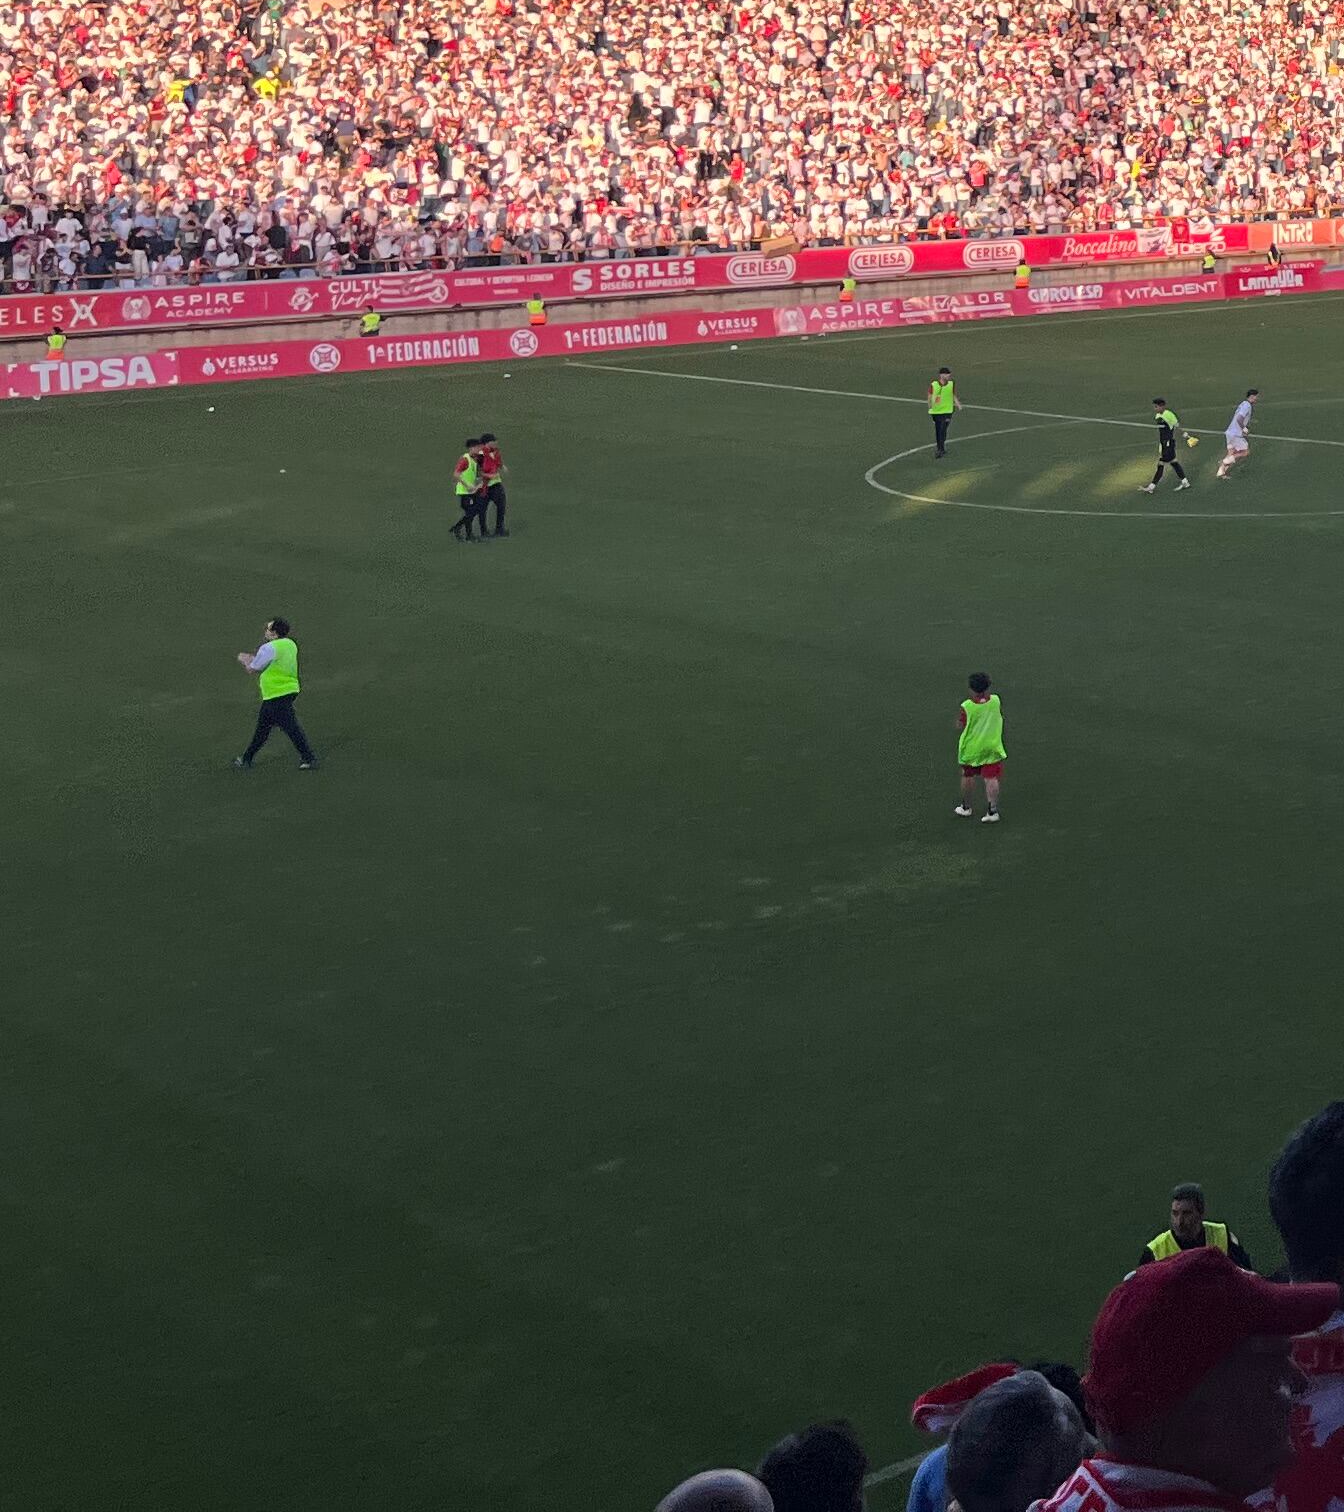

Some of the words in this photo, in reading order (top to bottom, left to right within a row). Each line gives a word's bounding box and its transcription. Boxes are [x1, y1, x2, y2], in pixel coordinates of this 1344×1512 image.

[968, 244, 1018, 265] CERLESA
[1062, 234, 1137, 257] Boccalino
[600, 260, 696, 280] SORLES
[853, 251, 906, 272] CERLESA
[600, 280, 635, 292] DISEÑO
[637, 280, 643, 289] E
[645, 277, 696, 288] IMPRESIÓN
[1123, 280, 1218, 299] VITALDENT
[154, 291, 246, 309] ASPIRE
[165, 306, 235, 319] ACADEMY
[809, 301, 894, 320] ASPIRE
[708, 316, 758, 330] VERSUS
[821, 318, 884, 331] ACADEMY
[582, 320, 668, 347] FEDERACIÓN
[387, 334, 480, 362] FEDERACIÓN
[216, 352, 279, 369] VERSUS
[30, 356, 157, 393] TIPSA
